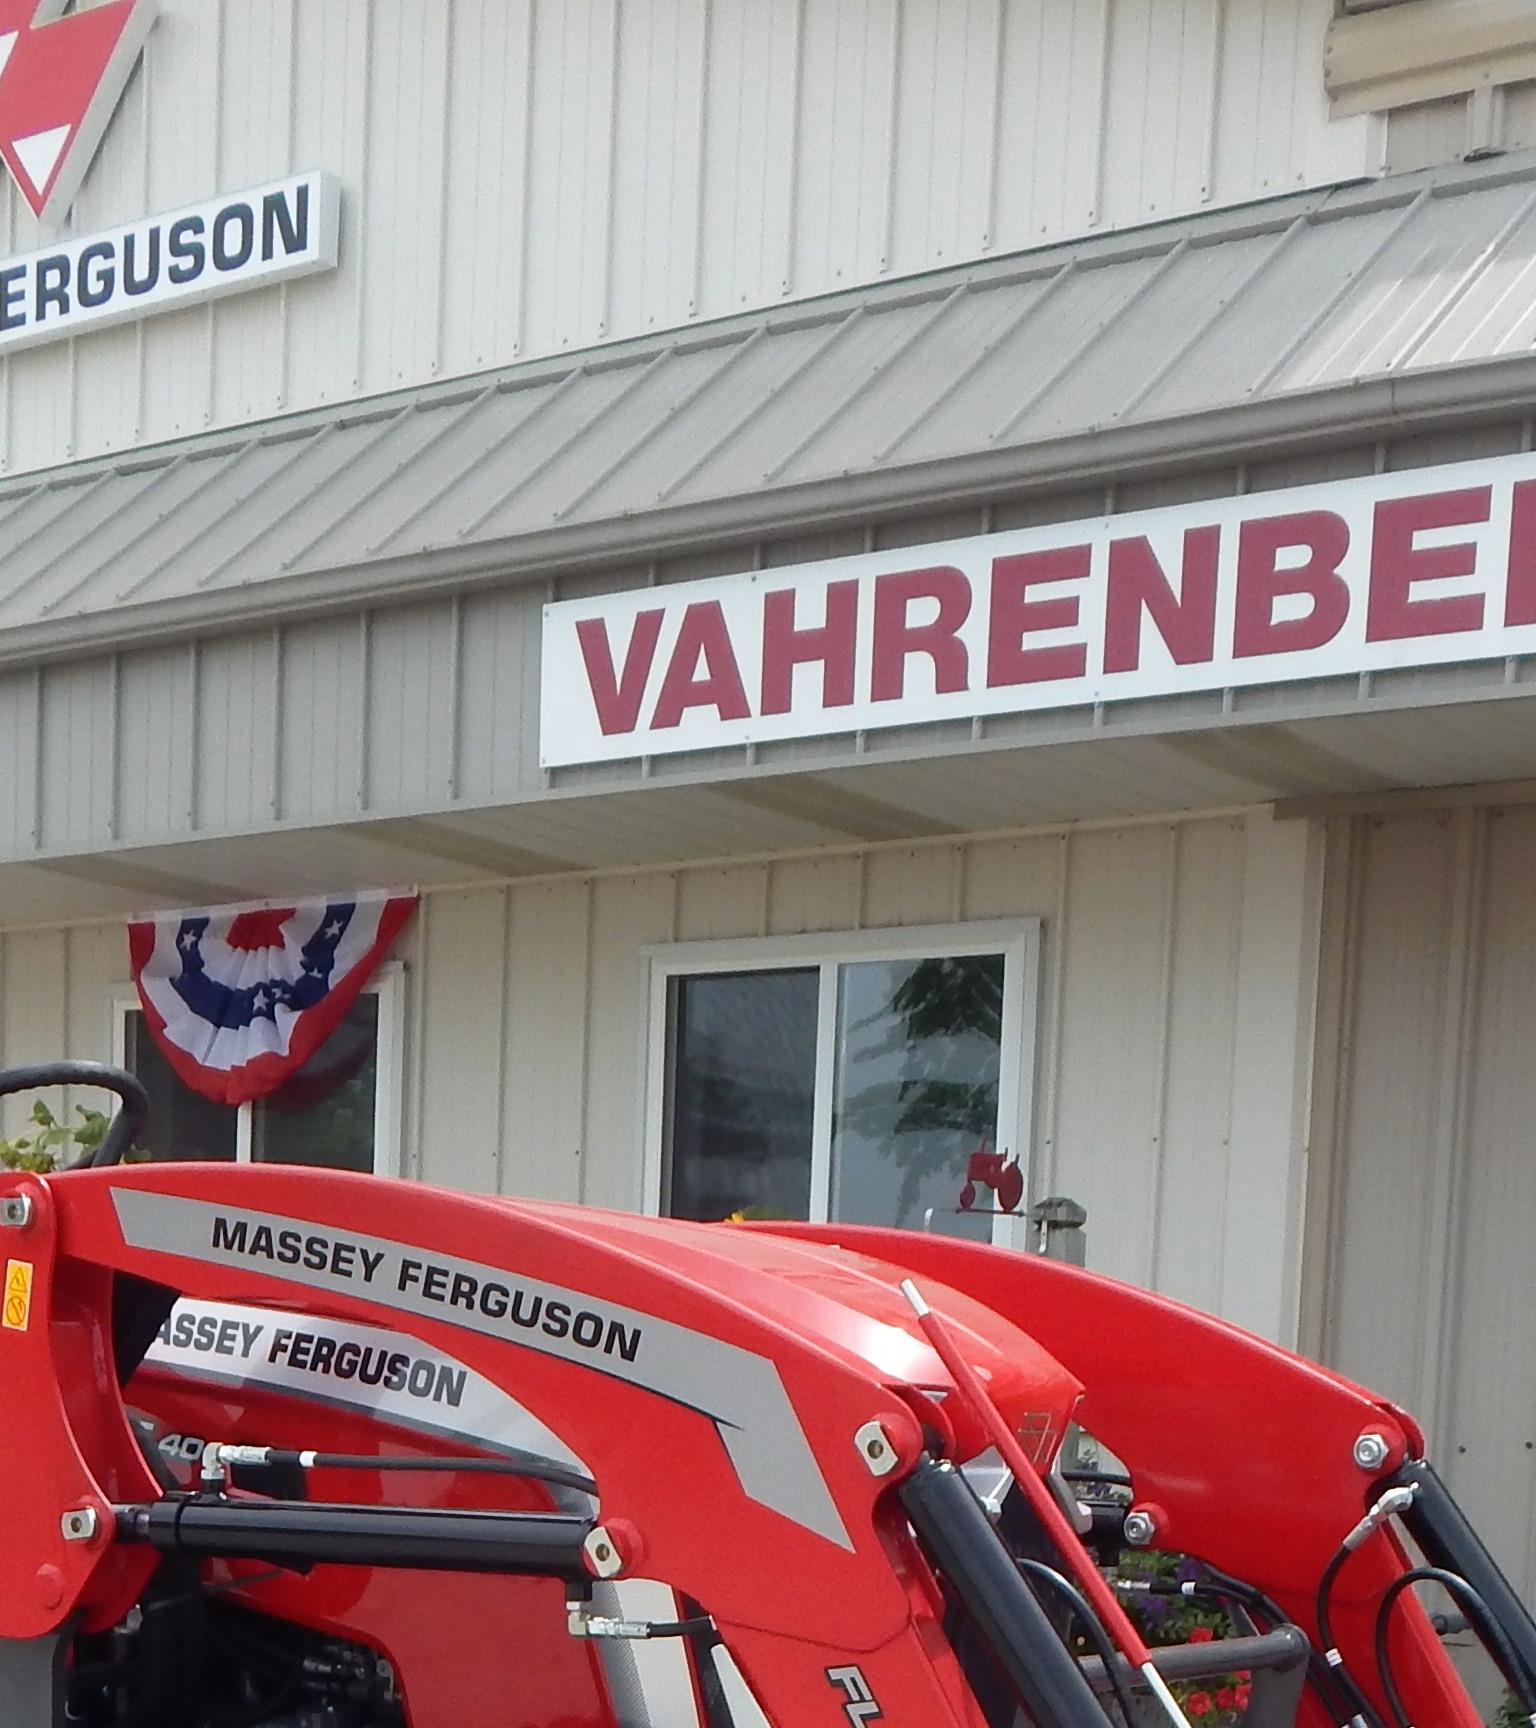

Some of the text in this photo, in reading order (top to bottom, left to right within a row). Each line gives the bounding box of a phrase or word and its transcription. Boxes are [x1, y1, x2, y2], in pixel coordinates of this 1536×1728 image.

[212, 1217, 642, 1363] MASSEY FERGUSON
[267, 1328, 467, 1407] FERGUSON
